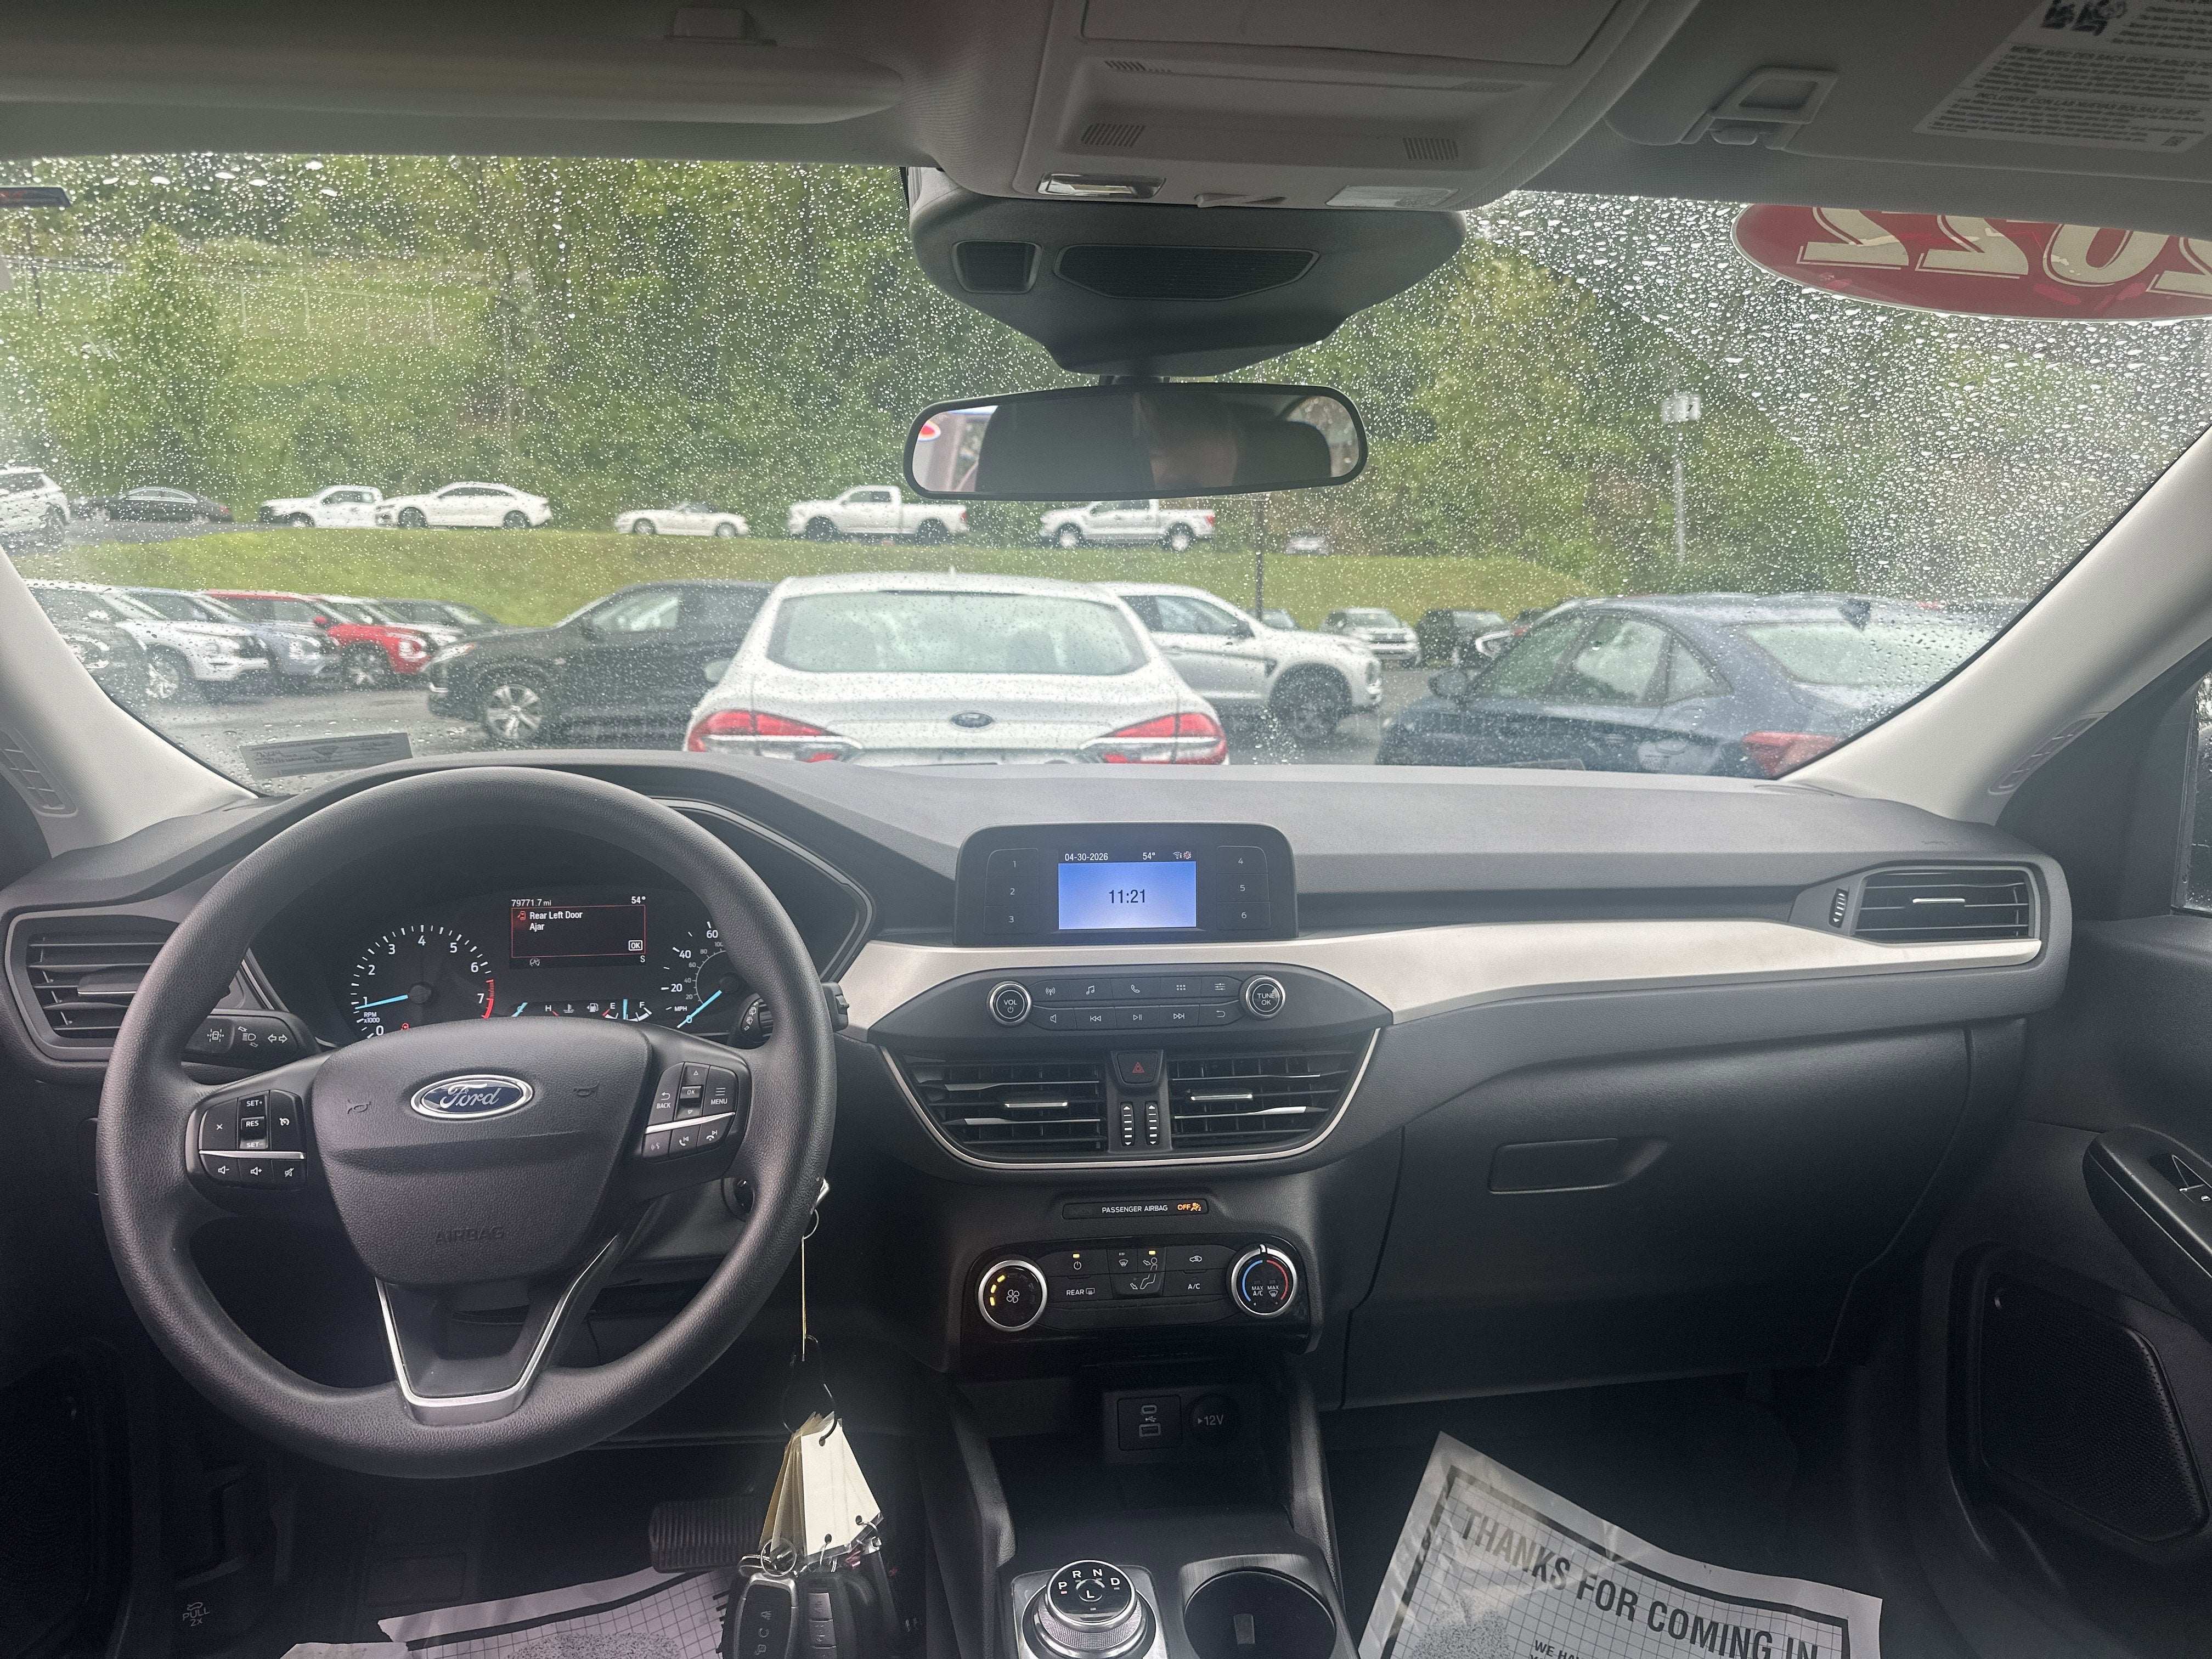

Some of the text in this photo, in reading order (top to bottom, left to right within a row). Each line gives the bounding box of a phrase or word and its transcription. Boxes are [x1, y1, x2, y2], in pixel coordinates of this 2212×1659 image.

[1064, 852, 1155, 861] 04-30-2026 54°
[631, 896, 646, 904] 54°
[1109, 889, 1146, 904] 11:21
[511, 899, 542, 907] 79771.7
[529, 911, 583, 919] Rear Left Door
[529, 922, 545, 932] Ajar
[706, 929, 719, 939] 60
[417, 935, 426, 946] 4
[388, 944, 396, 955] 3
[450, 942, 458, 953] 5
[640, 955, 646, 963] S
[679, 950, 691, 959] 40
[368, 964, 375, 975] 2
[471, 962, 479, 973] 6
[670, 983, 682, 992] 20
[363, 996, 368, 1006] 1
[477, 993, 484, 1004] 7
[376, 1025, 384, 1036] 0
[439, 1083, 502, 1108] Ford
[245, 1119, 259, 1127] RES
[1203, 1414, 1224, 1426] 12V
[1072, 1570, 1082, 1578] R
[1092, 1568, 1103, 1577] N
[1058, 1581, 1068, 1590] P
[1110, 1577, 1120, 1585] D
[1462, 1506, 1571, 1590] THANKS
[1576, 1572, 1638, 1622] FOR
[1647, 1600, 1773, 1659] COMING
[1086, 1590, 1095, 1599] L
[182, 1606, 211, 1622] PULL
[1534, 1639, 1555, 1657] WE
